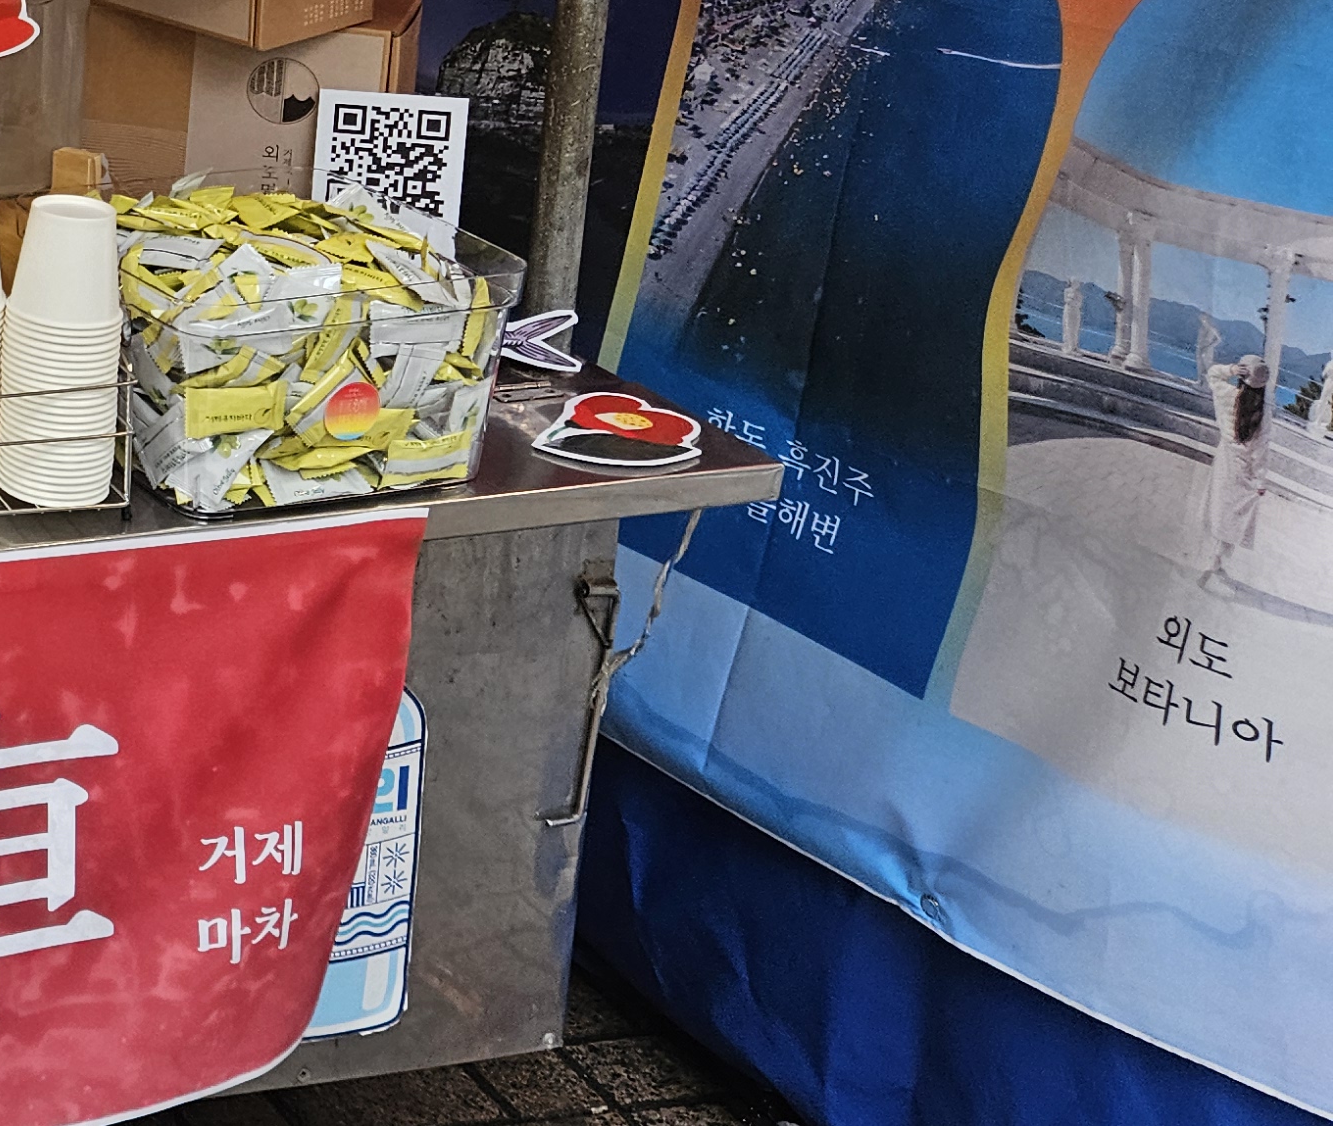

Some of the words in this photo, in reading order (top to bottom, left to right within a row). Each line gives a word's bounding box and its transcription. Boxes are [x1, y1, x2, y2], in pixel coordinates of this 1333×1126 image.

[777, 438, 875, 507] 흑진주
[746, 497, 841, 555] 해변
[1155, 614, 1233, 679] 외도
[1107, 657, 1284, 763] 보타니아
[198, 820, 303, 886] 거제
[196, 897, 299, 965] 마차
